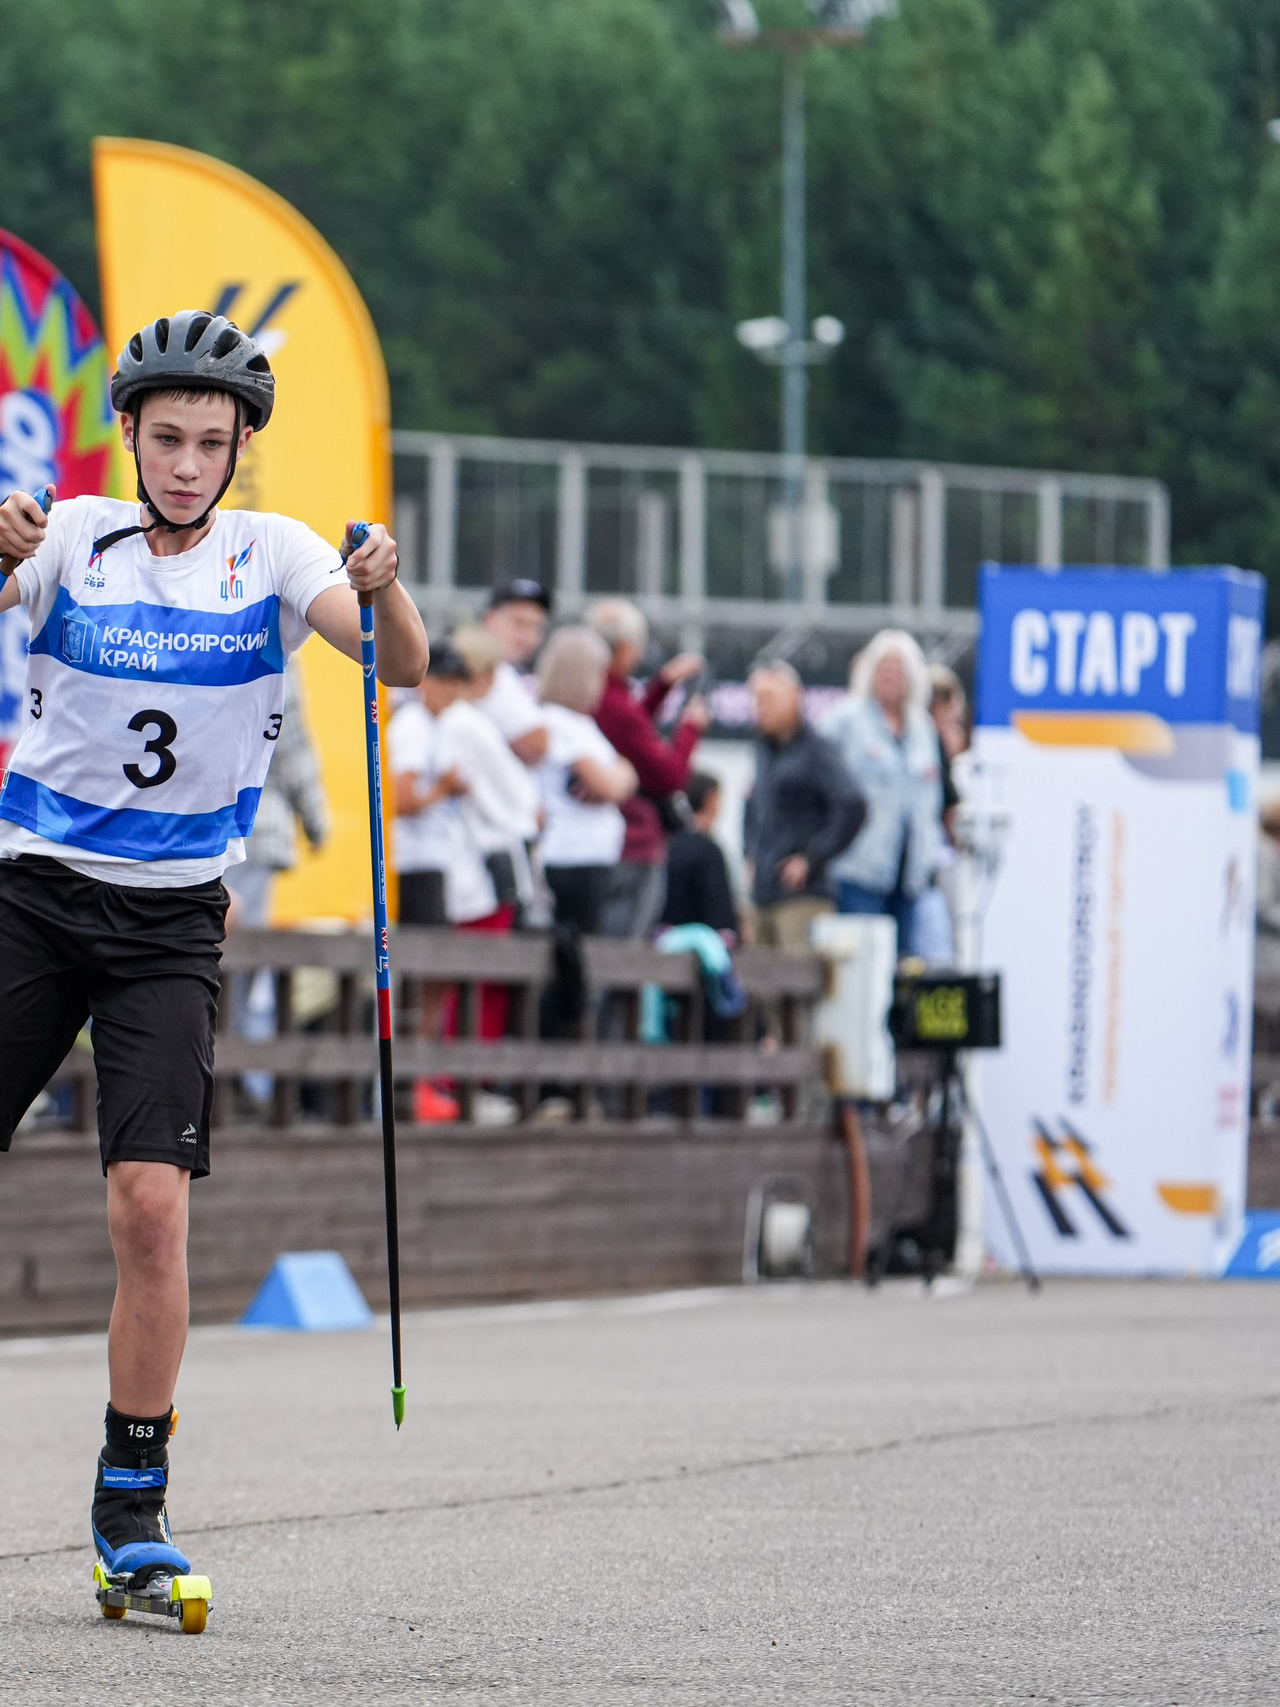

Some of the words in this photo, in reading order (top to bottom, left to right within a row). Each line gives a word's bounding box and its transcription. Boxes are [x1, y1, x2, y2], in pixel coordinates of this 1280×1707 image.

[102, 625, 270, 653] КРАСНОЯРСКИЙ
[1010, 608, 1197, 698] СТАРТ
[98, 648, 158, 672] КРАЙ
[30, 687, 43, 720] 3
[263, 713, 283, 741] 3
[122, 708, 178, 789] 3
[127, 1423, 155, 1438] 153
